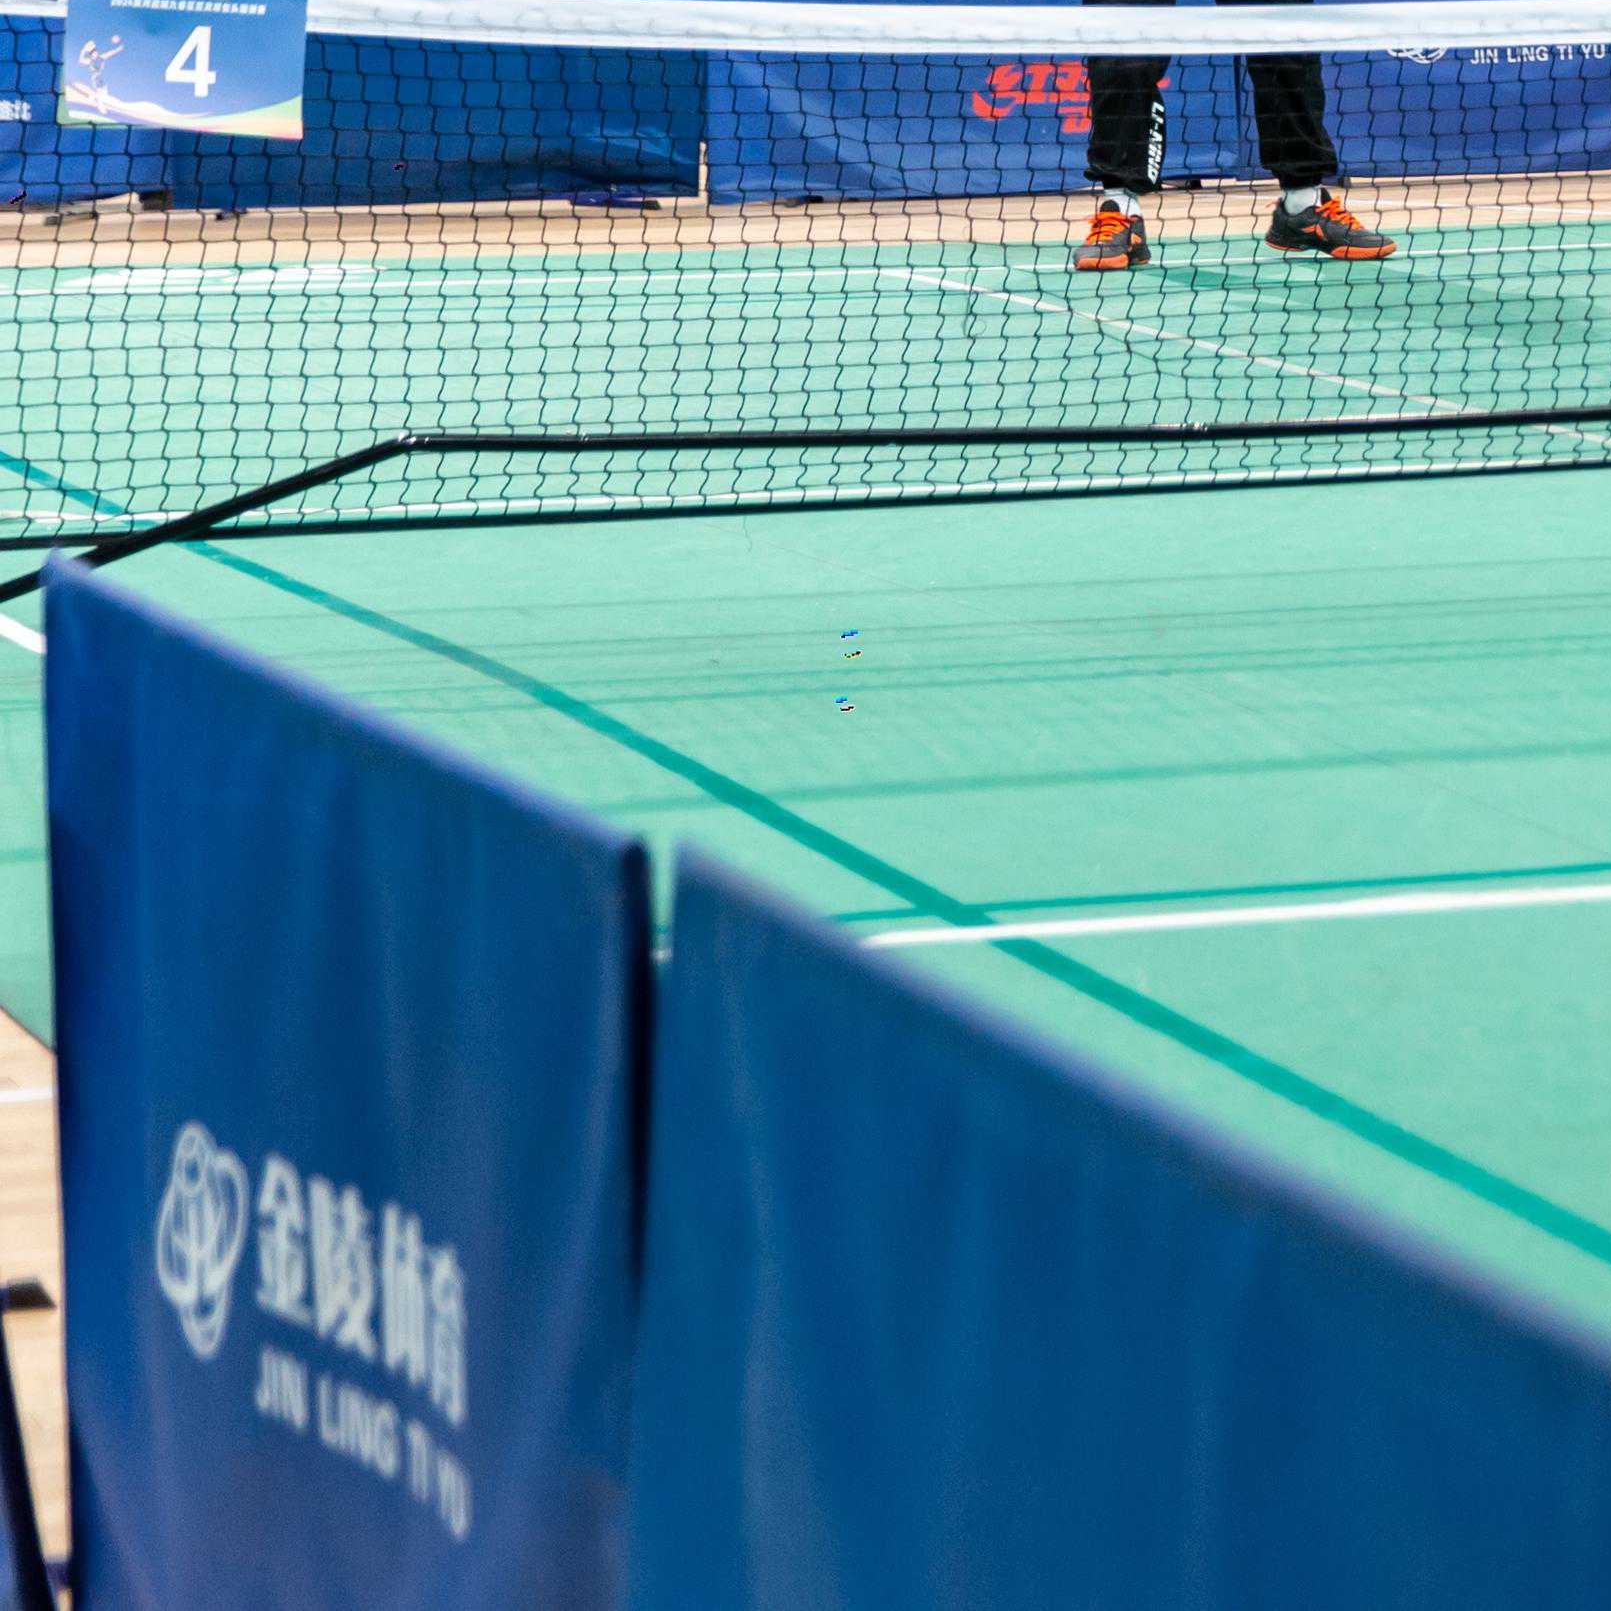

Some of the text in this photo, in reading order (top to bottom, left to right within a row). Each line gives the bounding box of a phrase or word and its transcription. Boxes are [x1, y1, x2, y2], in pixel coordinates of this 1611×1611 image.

[165, 25, 217, 98] 4
[1470, 43, 1606, 65] JIN LING TI YU
[255, 1150, 468, 1430] 金陵体育
[255, 1342, 310, 1433] JIN
[318, 1374, 400, 1480] LING
